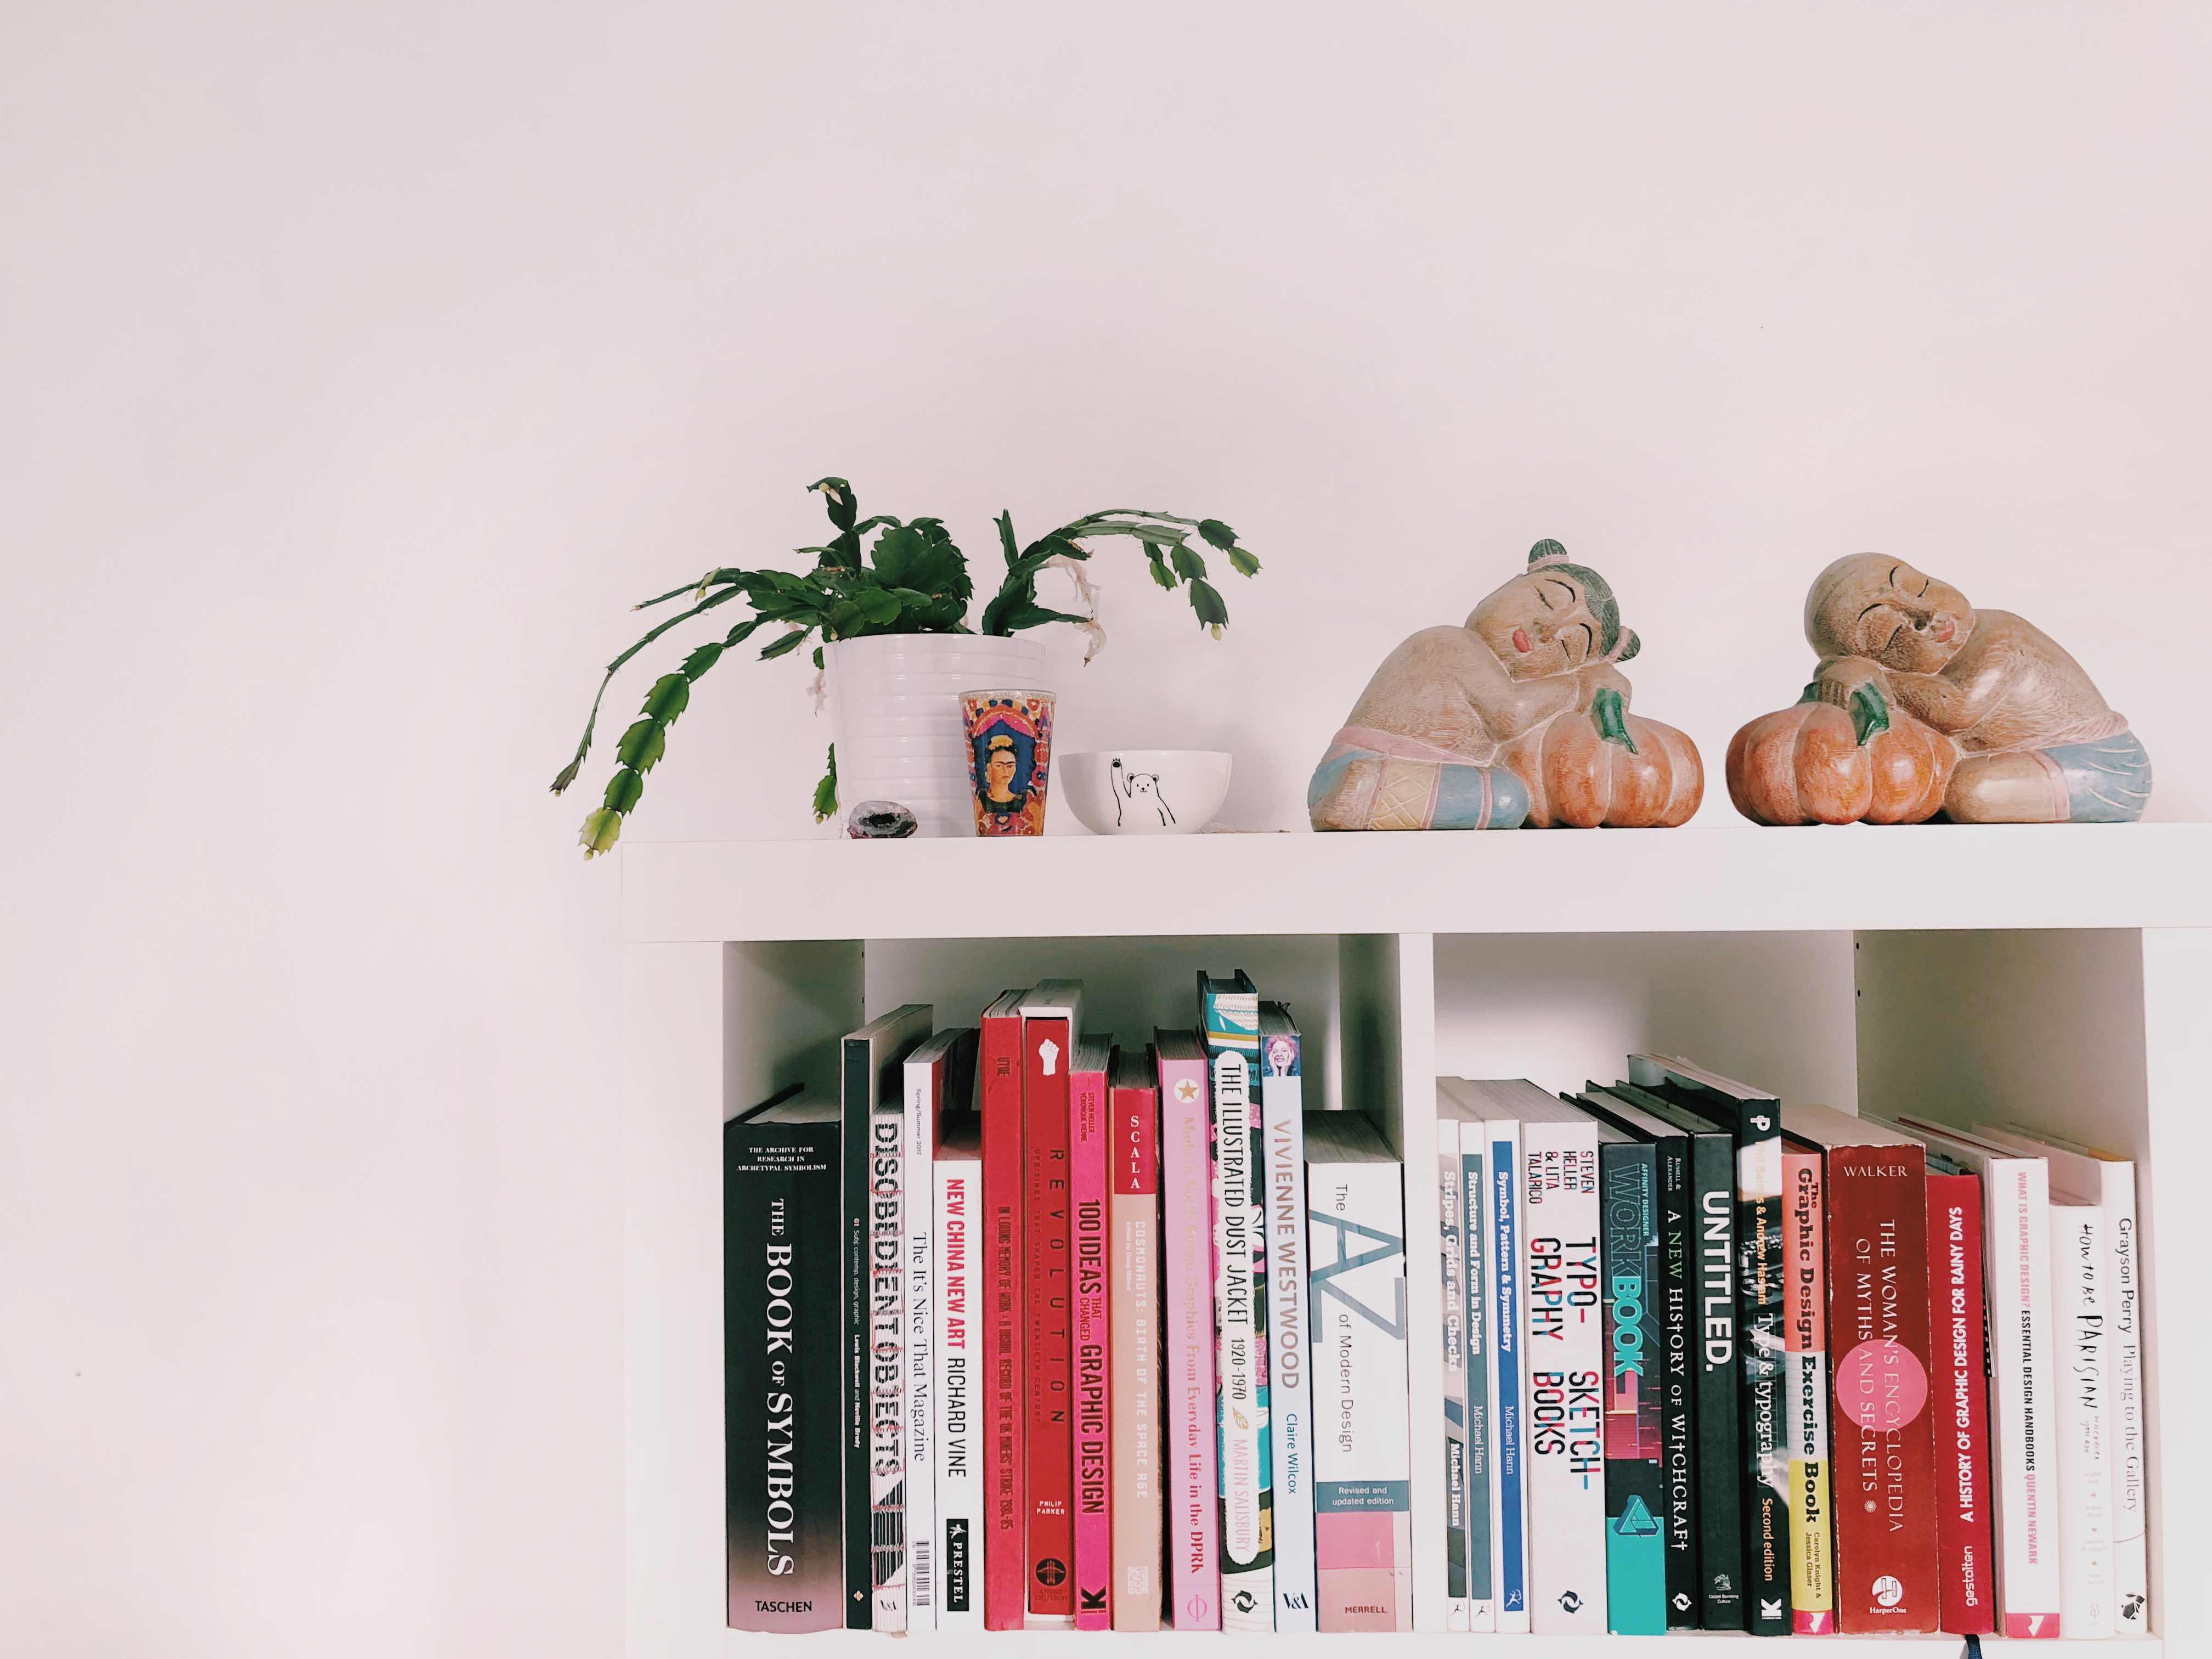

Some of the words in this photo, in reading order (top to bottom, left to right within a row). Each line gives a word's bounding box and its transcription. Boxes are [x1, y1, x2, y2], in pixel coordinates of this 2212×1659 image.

[1220, 1064, 1241, 1097] THE
[1221, 1101, 1246, 1209] ILLUSTRATED
[1545, 1151, 1558, 1162] &
[1562, 1151, 1578, 1190] HELLER
[1579, 1151, 1594, 1194] STEVEN
[1843, 1166, 1908, 1177] WALKER
[947, 1179, 964, 1215] NEW
[1273, 1120, 1294, 1236] VIVIENNE
[1335, 1184, 1349, 1211] The
[1497, 1171, 1510, 1223] Symbol,
[1528, 1151, 1542, 1204] TALARICO
[1545, 1166, 1559, 1189] LITA
[1809, 1182, 1819, 1209] The
[2018, 1171, 2028, 1198] WHAT
[771, 1199, 785, 1236] THE
[1078, 1200, 1101, 1232] 100
[1466, 1172, 1479, 1231] Structure
[1667, 1210, 1680, 1223] A
[1795, 1168, 1815, 1261] Graphic
[2018, 1201, 2028, 1214] IS
[872, 1124, 900, 1336] DISOBEDIENT
[947, 1220, 964, 1271] CHINA
[1224, 1215, 1247, 1257] DUST
[1468, 1234, 1480, 1258] and
[1880, 1220, 1895, 1257] THE
[1949, 1207, 1963, 1242] DAYS
[2018, 1216, 2029, 1261] GRAPHIC
[912, 1233, 928, 1263] The
[1079, 1235, 1102, 1295] IDEAS
[1499, 1226, 1512, 1271] Pattern
[1668, 1231, 1682, 1279] NEW
[1855, 1238, 1869, 1264] OF
[1950, 1244, 1965, 1284] RAINY
[2117, 1218, 2134, 1285] Grayson
[912, 1270, 928, 1292] It's
[947, 1276, 964, 1312] NEW
[1049, 1150, 1064, 1423] REVOLUTION
[1226, 1263, 1248, 1324] JACKET
[1469, 1260, 1481, 1293] Form
[1500, 1274, 1512, 1283] &
[1530, 1237, 1564, 1341] GRAPHY
[1565, 1237, 1597, 1324] TYPO-
[1703, 1190, 1731, 1372] UNTITLED.
[2019, 1265, 2030, 1307] DESIGN?
[766, 1243, 793, 1355] BOOK
[912, 1298, 928, 1333] Nice
[1080, 1297, 1091, 1341] CHANGED
[1091, 1297, 1102, 1319] THAT
[1277, 1243, 1300, 1389] WESTWOOD
[1470, 1297, 1481, 1308] in
[1498, 1287, 1514, 1351] Symmetry
[1797, 1267, 1817, 1350] Design
[1857, 1273, 1873, 1340] MYTHS
[1881, 1266, 1899, 1365] WOMAN'S
[1952, 1288, 1966, 1314] FOR
[2118, 1289, 2135, 1334] Perry
[947, 1317, 965, 1348] ART
[1338, 1314, 1352, 1329] of
[1467, 1312, 1482, 1355] Design
[1754, 1313, 1773, 1357] Type
[1953, 1317, 1968, 1367] DESIGN
[2021, 1310, 2032, 1363] ESSENTIAL
[772, 1361, 785, 1386] OF
[912, 1339, 929, 1378] That
[1186, 1344, 1201, 1381] From
[1230, 1336, 1248, 1400] 1920-1970
[1339, 1335, 1354, 1394] Modern
[1759, 1362, 1774, 1375] &
[1859, 1348, 1875, 1395] AND
[2072, 1314, 2103, 1409] PARISIAN
[2120, 1344, 2137, 1401] Playing
[947, 1357, 965, 1432] RICHARD
[1079, 1344, 1103, 1434] GRAPHIC
[1672, 1385, 1683, 1406] OF
[1801, 1356, 1817, 1455] Exercise
[1955, 1370, 1971, 1429] GRAPHIC
[2022, 1366, 2034, 1405] DESIGN
[874, 1342, 901, 1477] OBJECTS
[910, 1384, 929, 1462] Magazine
[1184, 1386, 1201, 1448] Everyday
[1284, 1413, 1297, 1449] Claire
[1339, 1400, 1355, 1453] Design
[1472, 1406, 1484, 1447] Michael
[1504, 1406, 1515, 1447] Michael
[1533, 1372, 1565, 1456] BOOKS
[1569, 1371, 1601, 1490] SKETCH-
[2123, 1405, 2136, 1422] to
[1756, 1381, 1774, 1487] typography
[1860, 1402, 1877, 1491] SECRETS
[1884, 1372, 1903, 1532] ENCYCLOPEDIA
[1956, 1431, 1971, 1450] OF
[2023, 1408, 2035, 1471] HANDBOOKS
[2124, 1426, 2138, 1452] the
[947, 1439, 966, 1477] VINE
[1081, 1441, 1104, 1513] DESIGN
[1188, 1453, 1203, 1481] Life
[1232, 1440, 1249, 1483] MARTIN
[1285, 1454, 1300, 1494] Wilcox
[1449, 1443, 1461, 1494] Michael
[1474, 1449, 1485, 1474] Hann
[1505, 1449, 1516, 1474] Hann
[1958, 1453, 1972, 1506] HISTORY
[767, 1392, 794, 1576] SYMBOLS
[1189, 1486, 1203, 1496] in
[1804, 1462, 1820, 1522] Book
[2025, 1474, 2036, 1517] QUENTIN
[2123, 1455, 2140, 1512] Gallery
[1189, 1500, 1203, 1525] the
[1233, 1489, 1254, 1552] SALISBURY
[1451, 1497, 1462, 1526] Hann
[1762, 1498, 1773, 1539] Second
[1960, 1507, 1973, 1522] A
[1190, 1531, 1204, 1574] DPRK
[1764, 1542, 1774, 1581] edition
[2027, 1521, 2038, 1564] NEWARK
[952, 1542, 963, 1603] PRESTEL
[1962, 1546, 1978, 1606] gestalten
[755, 1600, 812, 1612] TASCHEN
[1283, 1593, 1308, 1609] V&A
